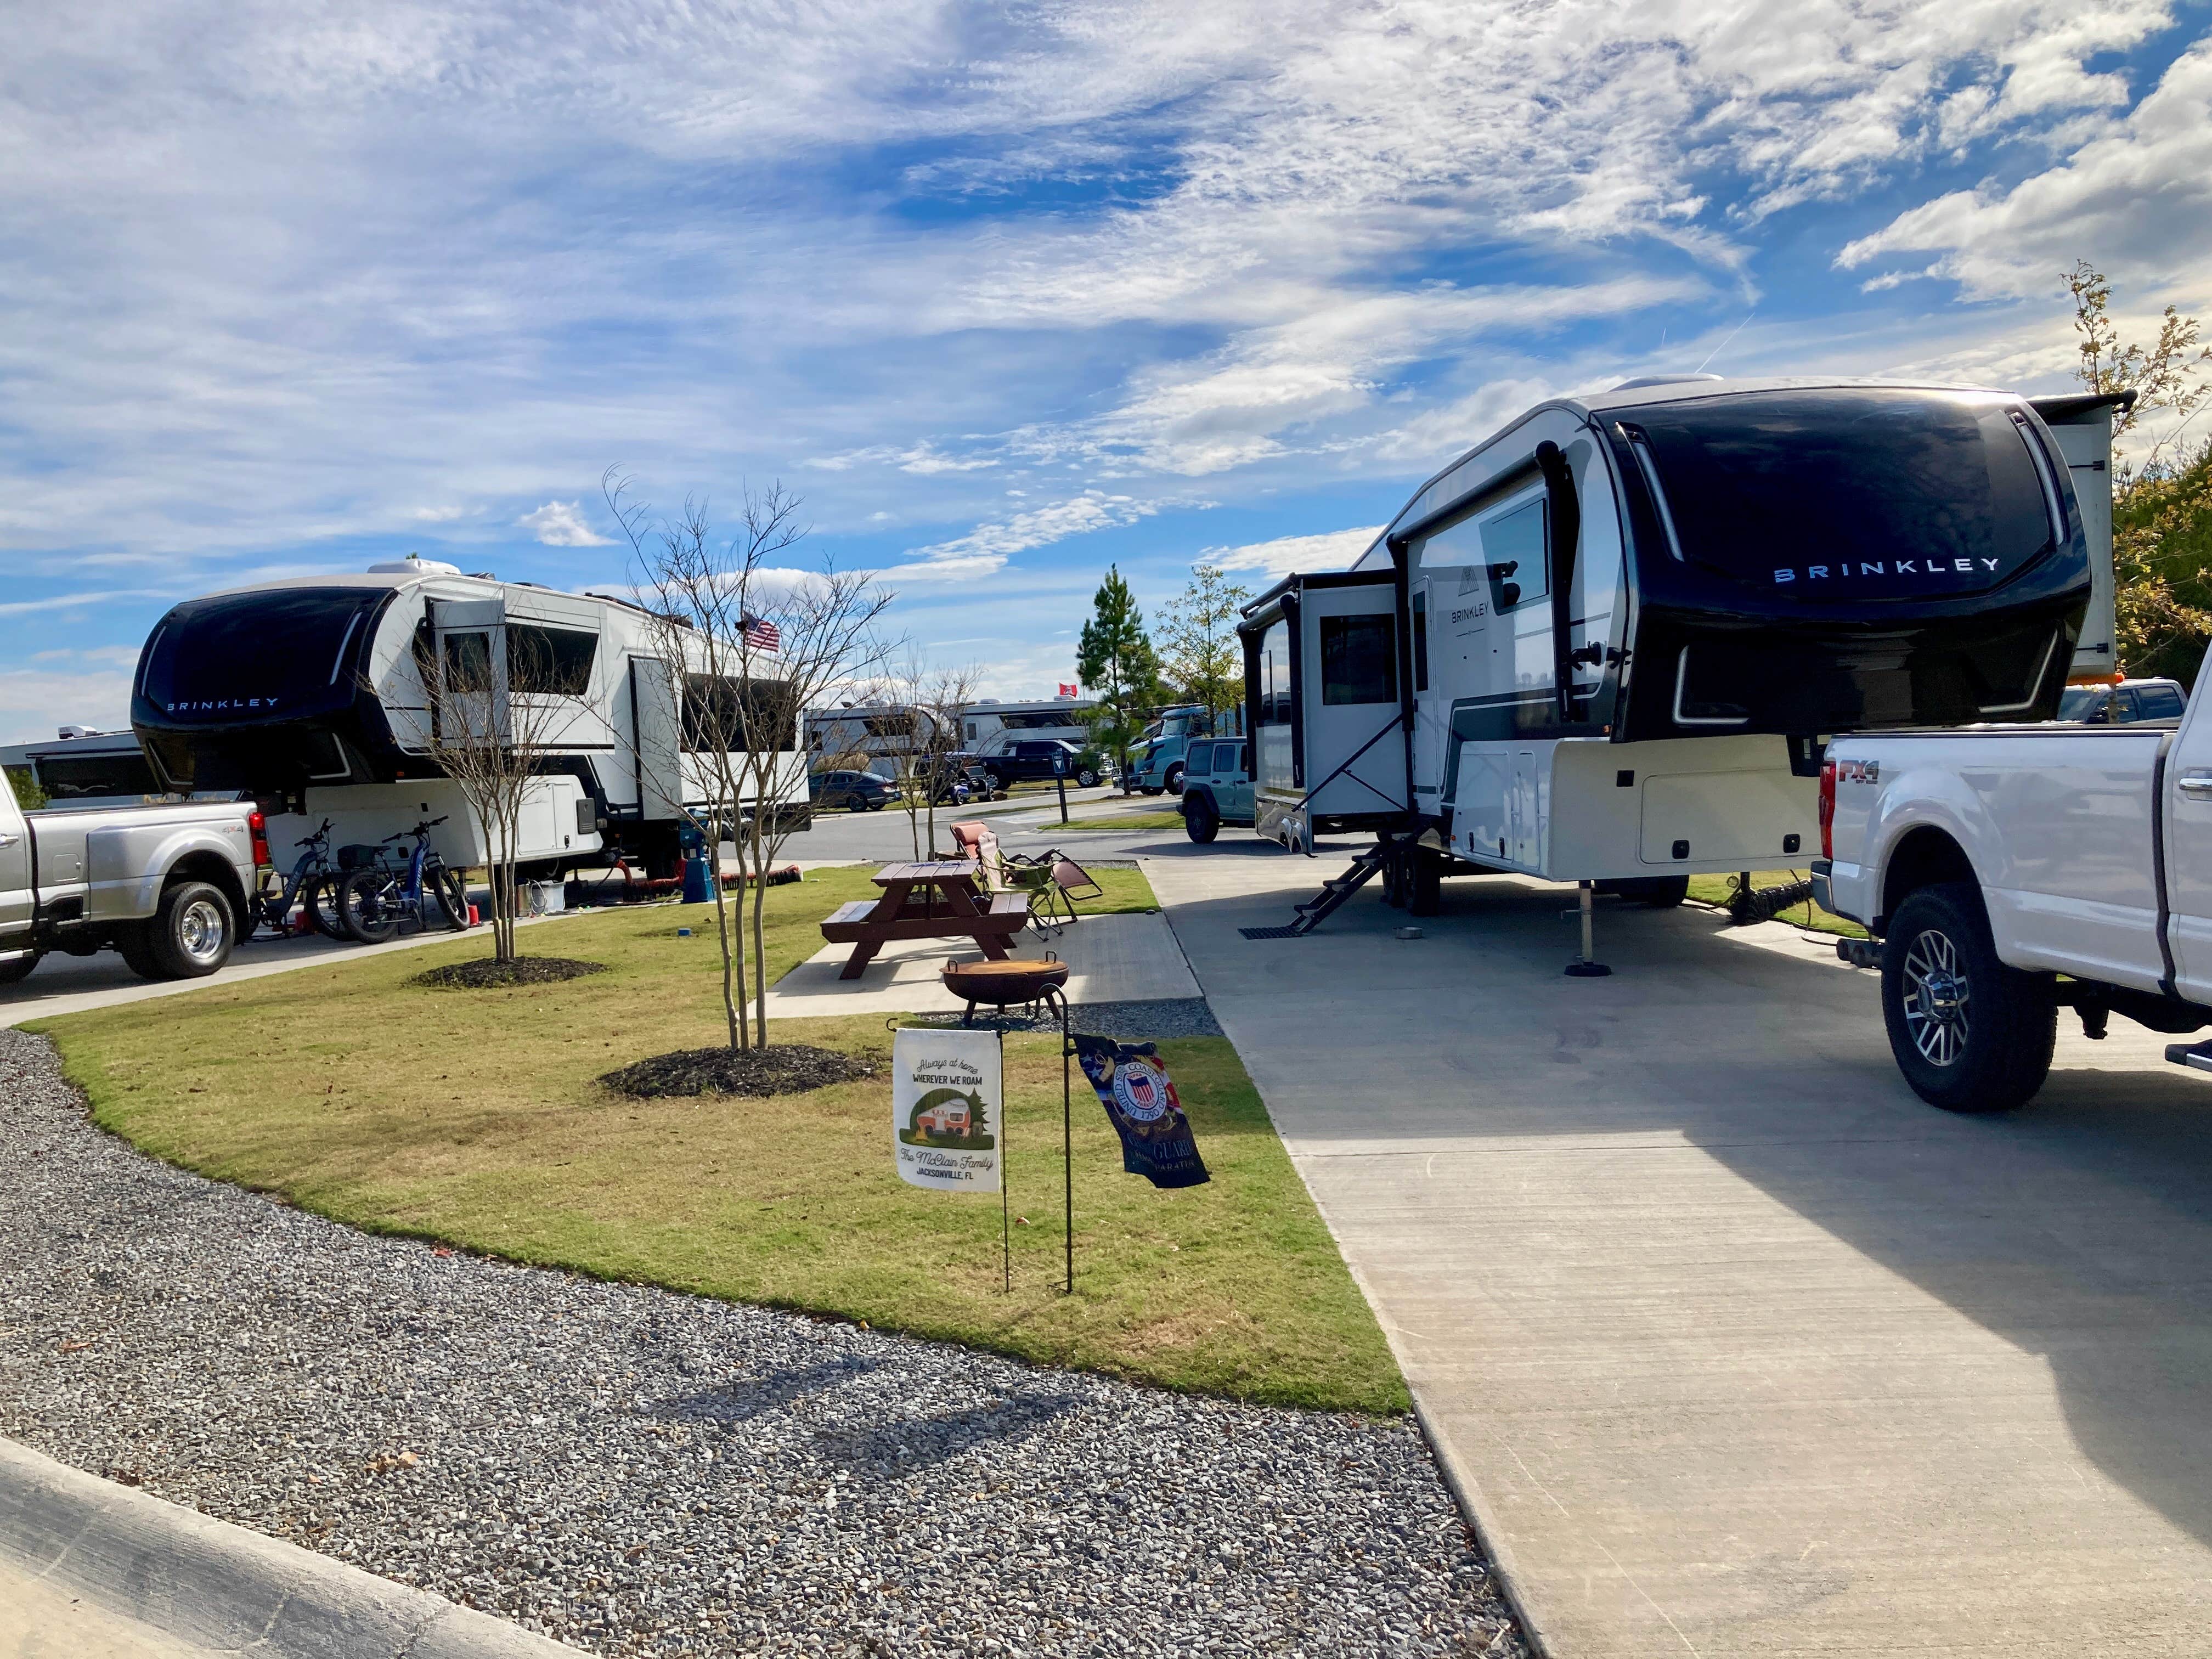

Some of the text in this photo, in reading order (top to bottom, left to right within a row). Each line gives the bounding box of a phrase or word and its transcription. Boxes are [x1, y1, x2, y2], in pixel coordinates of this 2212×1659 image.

[1774, 558, 1999, 583] BRINKLEY
[1452, 601, 1489, 624] BRINKLEY
[167, 698, 279, 711] BRINKLEY
[1838, 759, 1880, 782] FX4
[917, 1058, 979, 1075] Always at home
[912, 1074, 983, 1085] WHEREVER WE ROAM
[900, 1148, 994, 1170] The McClain Family
[917, 1167, 974, 1180] JACKSONVILLE, FL
